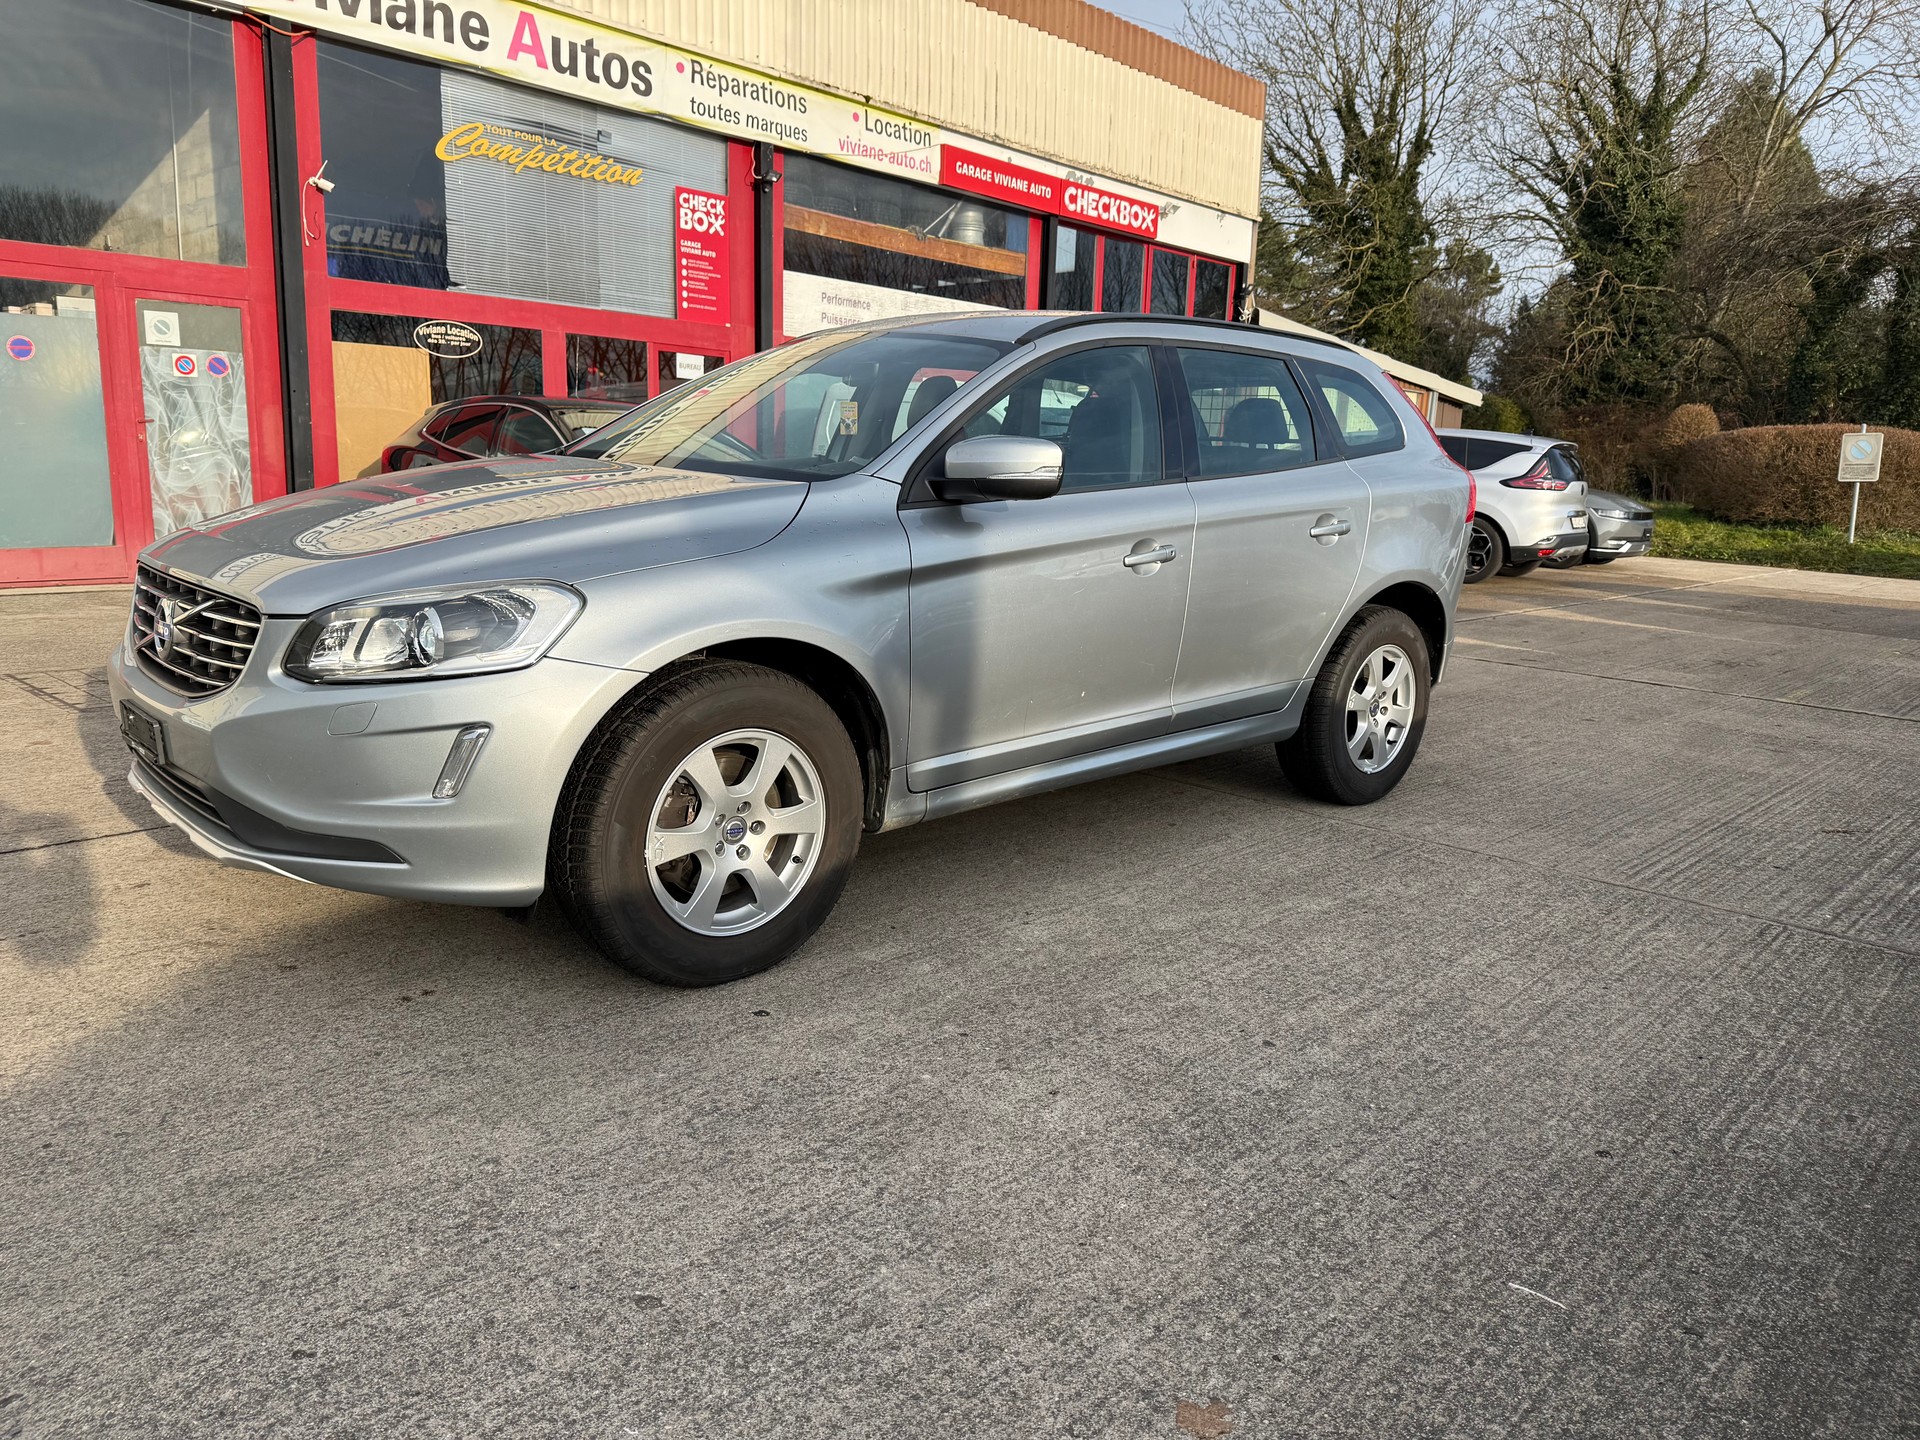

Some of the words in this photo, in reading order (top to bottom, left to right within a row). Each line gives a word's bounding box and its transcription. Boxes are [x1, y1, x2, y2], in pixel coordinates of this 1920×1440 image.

[506, 10, 653, 97] Autos
[690, 58, 808, 115] Réparations
[486, 124, 513, 136] TOUT
[514, 131, 543, 144] POUR
[544, 137, 557, 147] LA
[690, 96, 741, 125] toutes
[746, 114, 808, 142] marques
[864, 109, 932, 147] Location
[435, 122, 644, 186] Compétition
[838, 136, 932, 174] viviane-auto.ch
[955, 161, 992, 182] GARAGE
[994, 172, 1028, 192] VIVIANE
[1029, 183, 1052, 199] AUTO
[679, 192, 725, 216] CHECK
[1064, 186, 1156, 232] CHECKBOX
[680, 208, 725, 237] BOX
[680, 239, 701, 249] GARAGE
[680, 246, 702, 256] VIVIANE
[702, 249, 716, 258] AUTO
[821, 292, 871, 310] Performance
[419, 325, 446, 335] Viviane
[447, 324, 478, 341] Location
[679, 362, 702, 371] BUREAU
